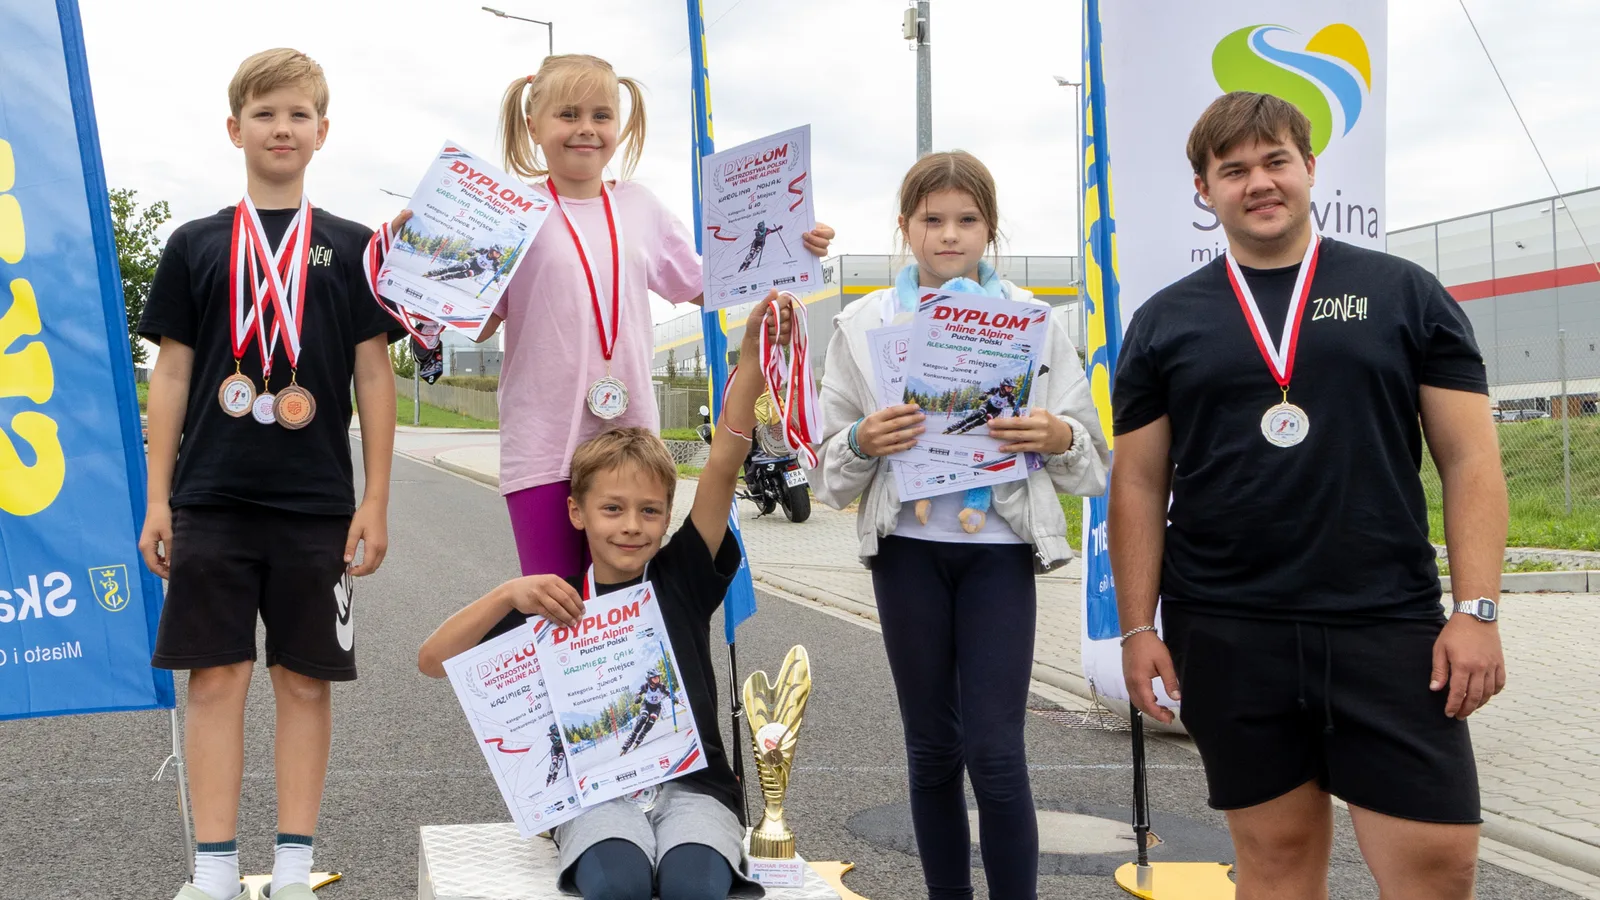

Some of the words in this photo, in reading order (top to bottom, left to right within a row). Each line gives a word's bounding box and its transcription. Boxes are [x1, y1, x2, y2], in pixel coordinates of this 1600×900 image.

[724, 143, 788, 176] DYPLOM
[725, 166, 766, 183] MISTRZOSTWA
[766, 160, 788, 170] POLSKI
[449, 160, 534, 212] DYPLOM
[739, 174, 758, 184] INLINE
[758, 168, 780, 179] ALPINE
[457, 178, 485, 196] Inline
[484, 194, 516, 216] Alpine
[460, 188, 484, 204] Puchar
[484, 201, 505, 216] Polski
[757, 191, 777, 199] Miejsce
[468, 215, 493, 232] miejsce
[932, 305, 1031, 331] DYPLOM
[1312, 293, 1367, 322] ZONE4!
[945, 323, 976, 335] Inline
[977, 328, 1014, 341] Alpine
[951, 333, 978, 342] Puchar
[979, 337, 1003, 346] Polski
[922, 362, 949, 371] Kategoria
[968, 359, 998, 369] miejsce
[552, 601, 640, 645] DYPLOM
[570, 635, 600, 651] Inline
[602, 624, 634, 641] Alpine
[580, 644, 605, 656] Puchar
[606, 636, 628, 648] Polski
[476, 640, 537, 680] DYPLO
[563, 656, 607, 676] KAZIMIERZ
[613, 648, 635, 661] GAIK
[607, 660, 635, 674] miejsce
[484, 660, 533, 687] MISTRZOSTWA
[495, 682, 504, 690] W
[504, 671, 527, 687] INLINE
[528, 664, 541, 676] ALP
[489, 685, 532, 708] KAZIMIERZ
[567, 685, 594, 697] Kategoria
